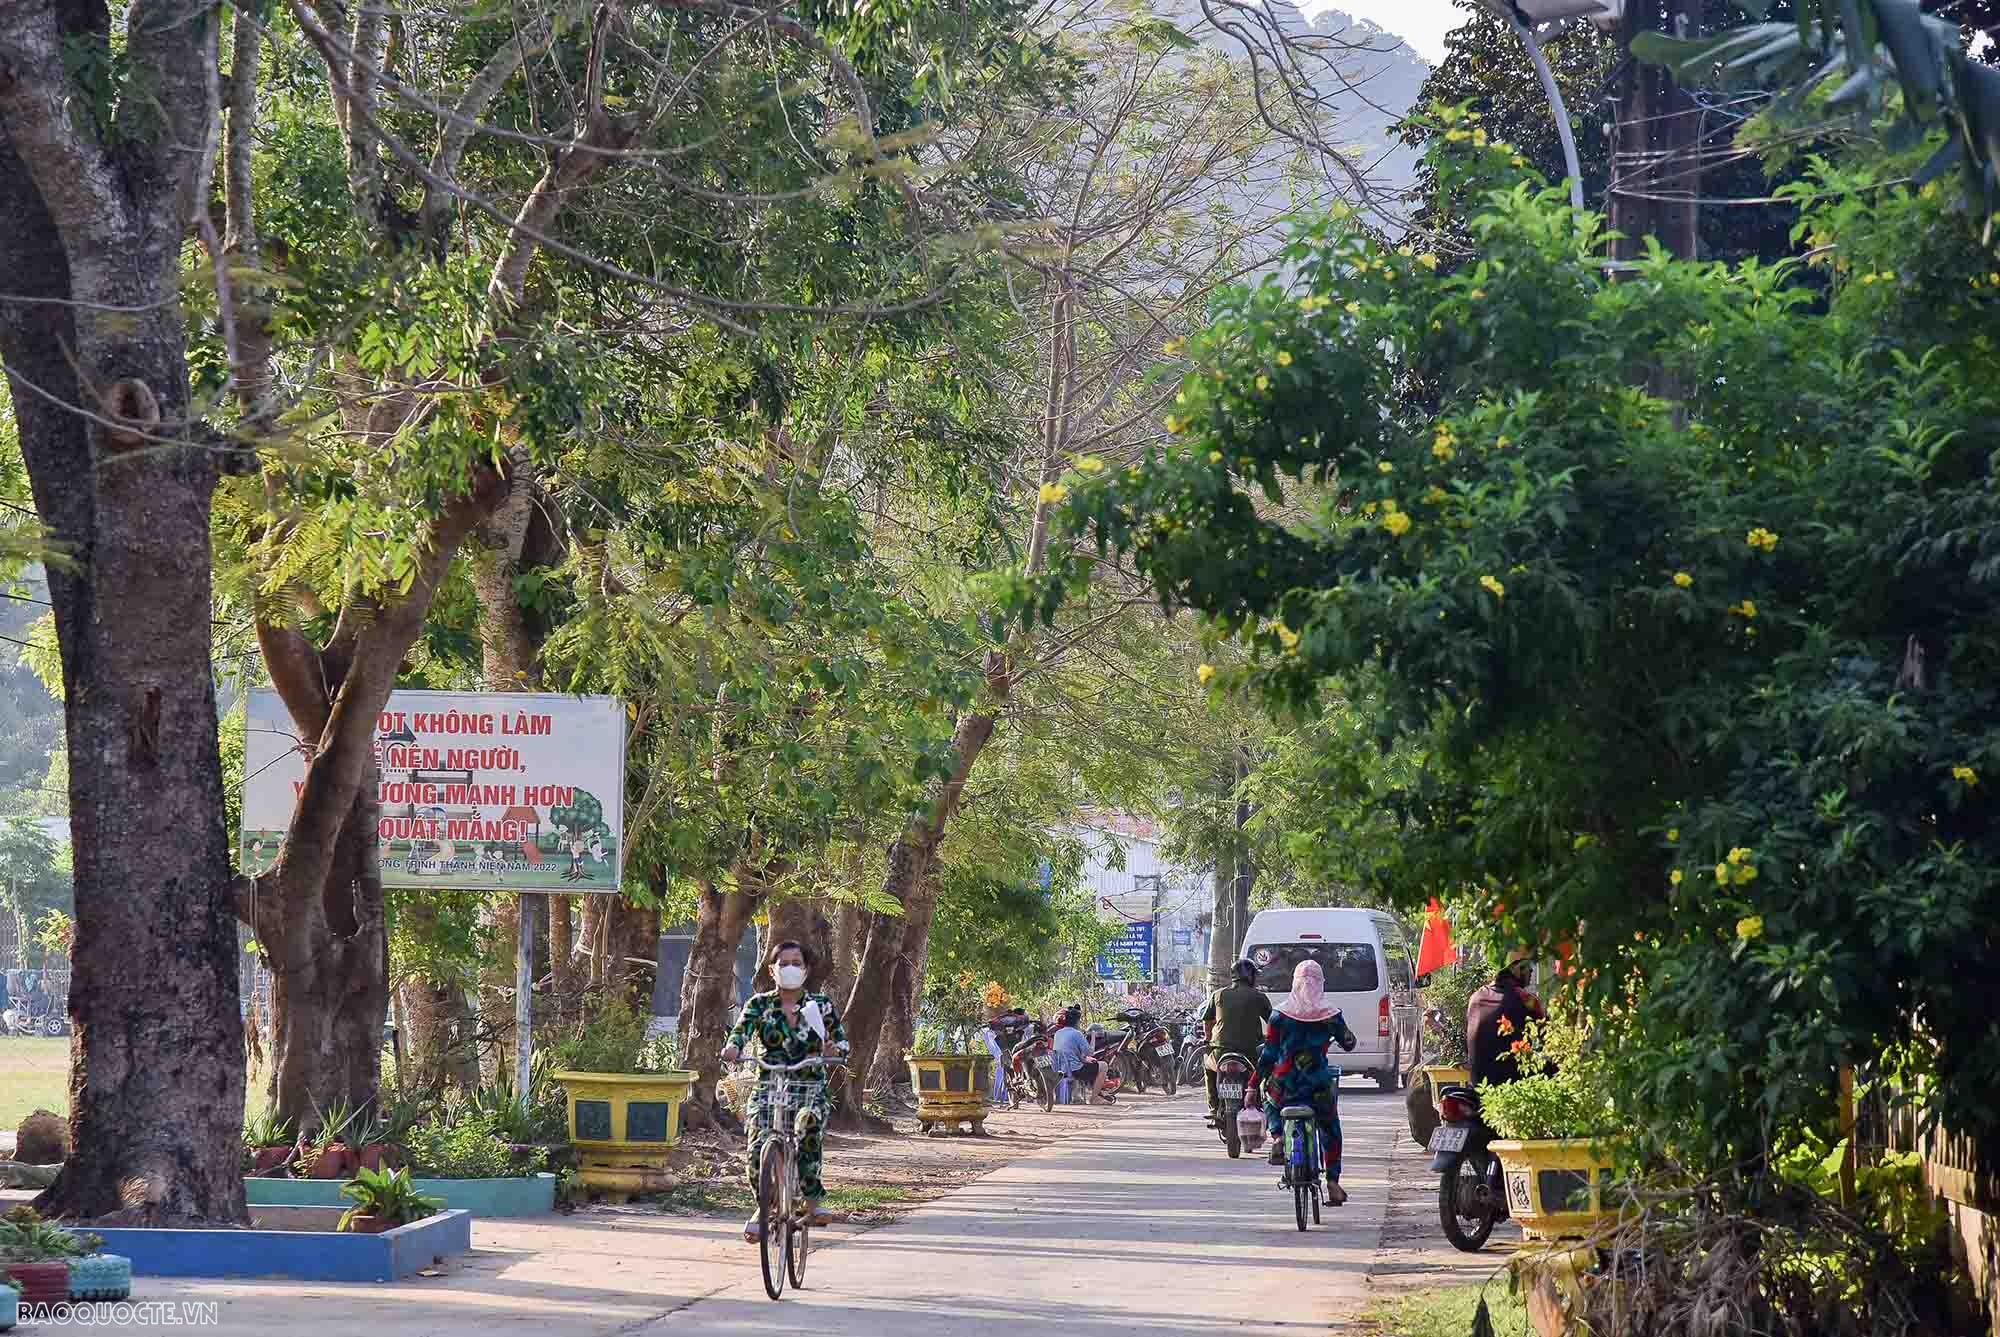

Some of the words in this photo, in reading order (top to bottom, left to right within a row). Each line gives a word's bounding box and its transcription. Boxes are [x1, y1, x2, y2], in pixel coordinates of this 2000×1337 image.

[378, 711, 406, 737] ỌT
[414, 709, 493, 735] KHÔNG
[501, 710, 551, 735] LÀM
[391, 744, 439, 769] NÊN
[447, 745, 527, 774] NGƯỜI,
[445, 784, 516, 809] MẠNH
[524, 785, 573, 806] HƠN
[378, 815, 438, 842] QUÁT
[440, 860, 475, 870] THANH
